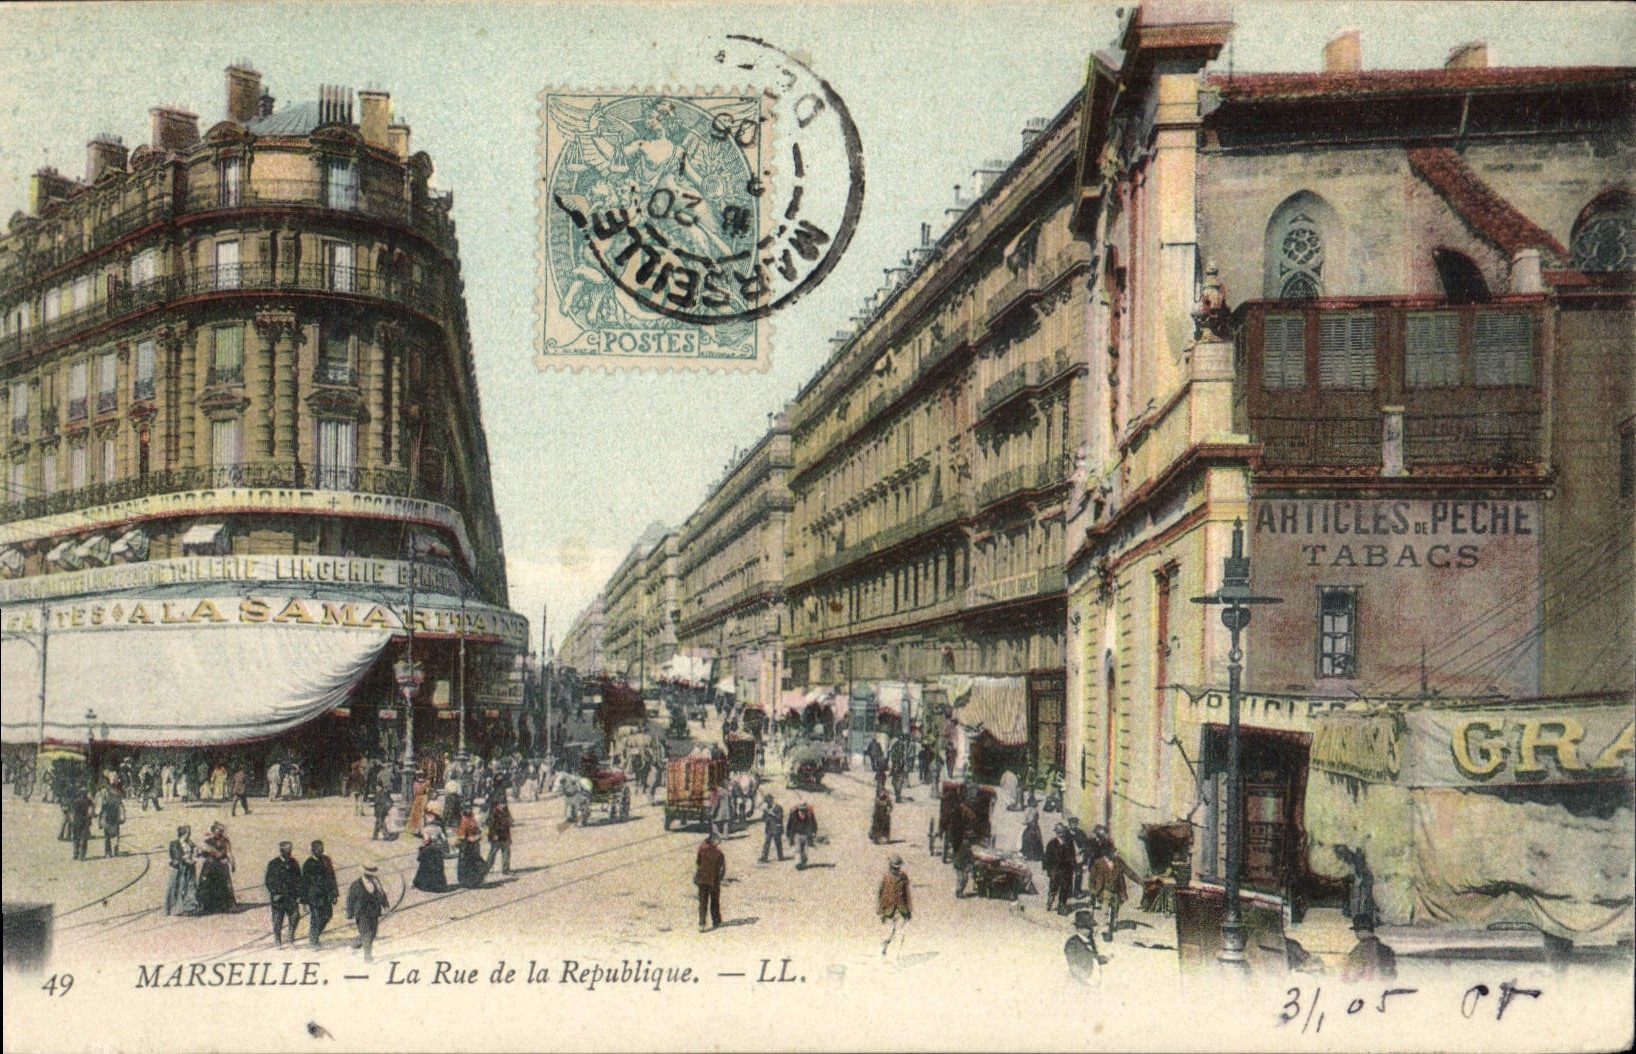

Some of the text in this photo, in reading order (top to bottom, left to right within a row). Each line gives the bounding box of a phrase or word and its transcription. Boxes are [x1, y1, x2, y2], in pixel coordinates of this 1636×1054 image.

[591, 208, 830, 308] MARSEILLE
[603, 331, 695, 353] POSTES
[1255, 499, 1412, 535] ARTICLES
[1414, 521, 1428, 535] DE
[276, 557, 385, 584] LINGERIE
[1301, 544, 1480, 569] TABACS
[161, 600, 228, 624] LA
[238, 597, 526, 642] SAMARITAINE
